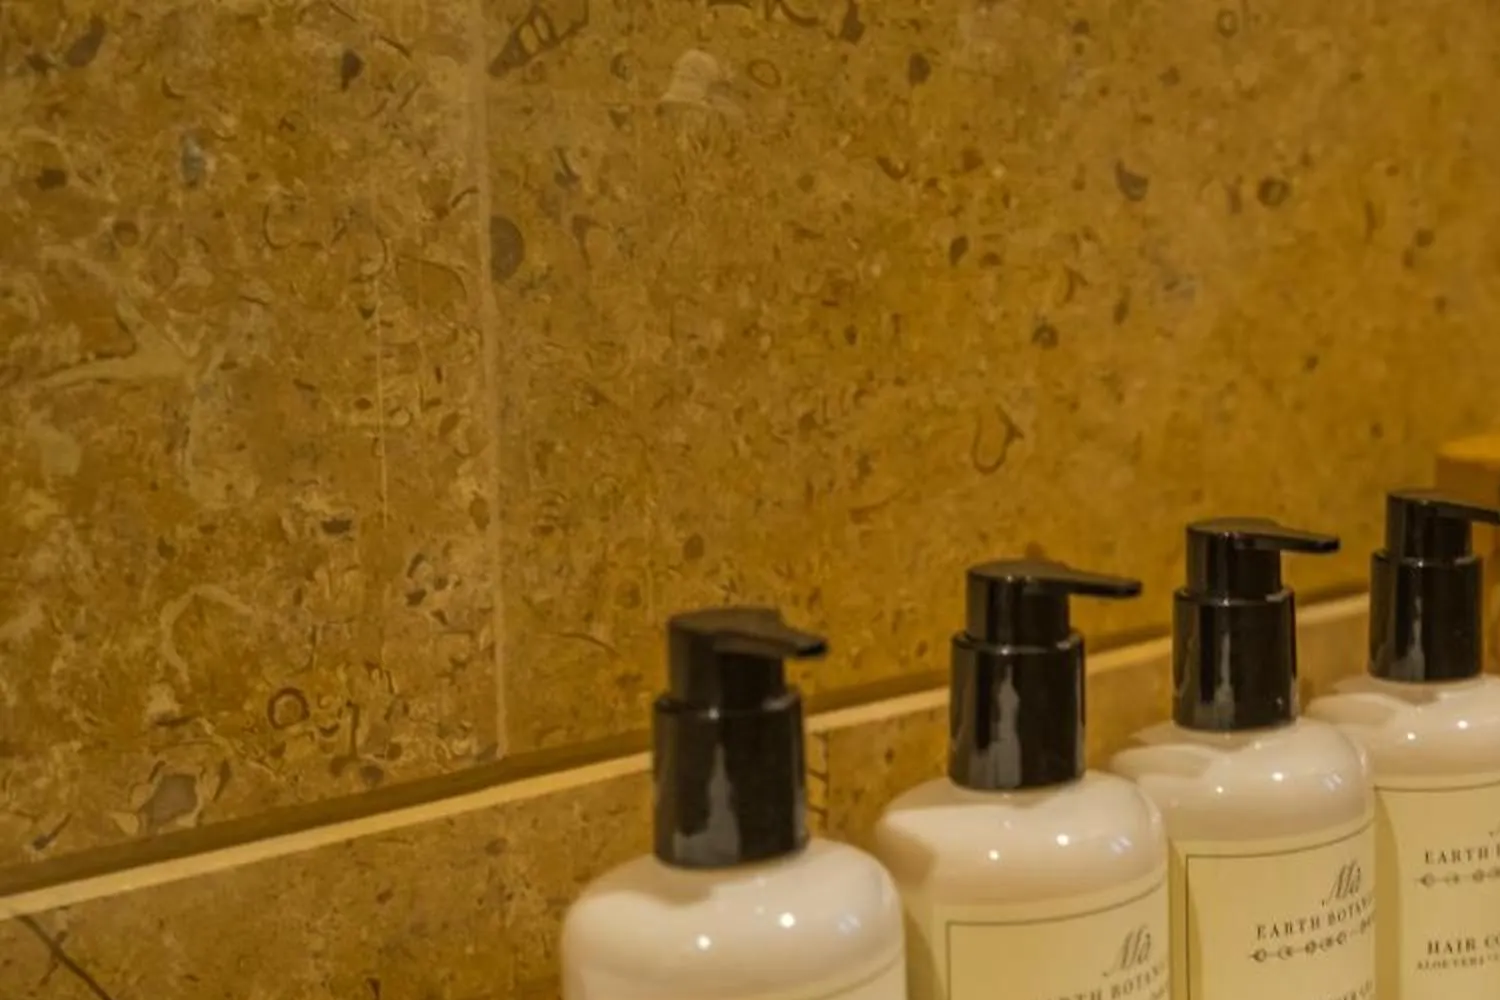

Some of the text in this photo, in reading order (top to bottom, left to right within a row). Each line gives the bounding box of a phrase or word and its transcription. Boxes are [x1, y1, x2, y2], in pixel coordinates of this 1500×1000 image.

[1424, 845, 1489, 865] EARTH
[1256, 915, 1321, 940] EARTH
[1426, 937, 1476, 956] HAIR
